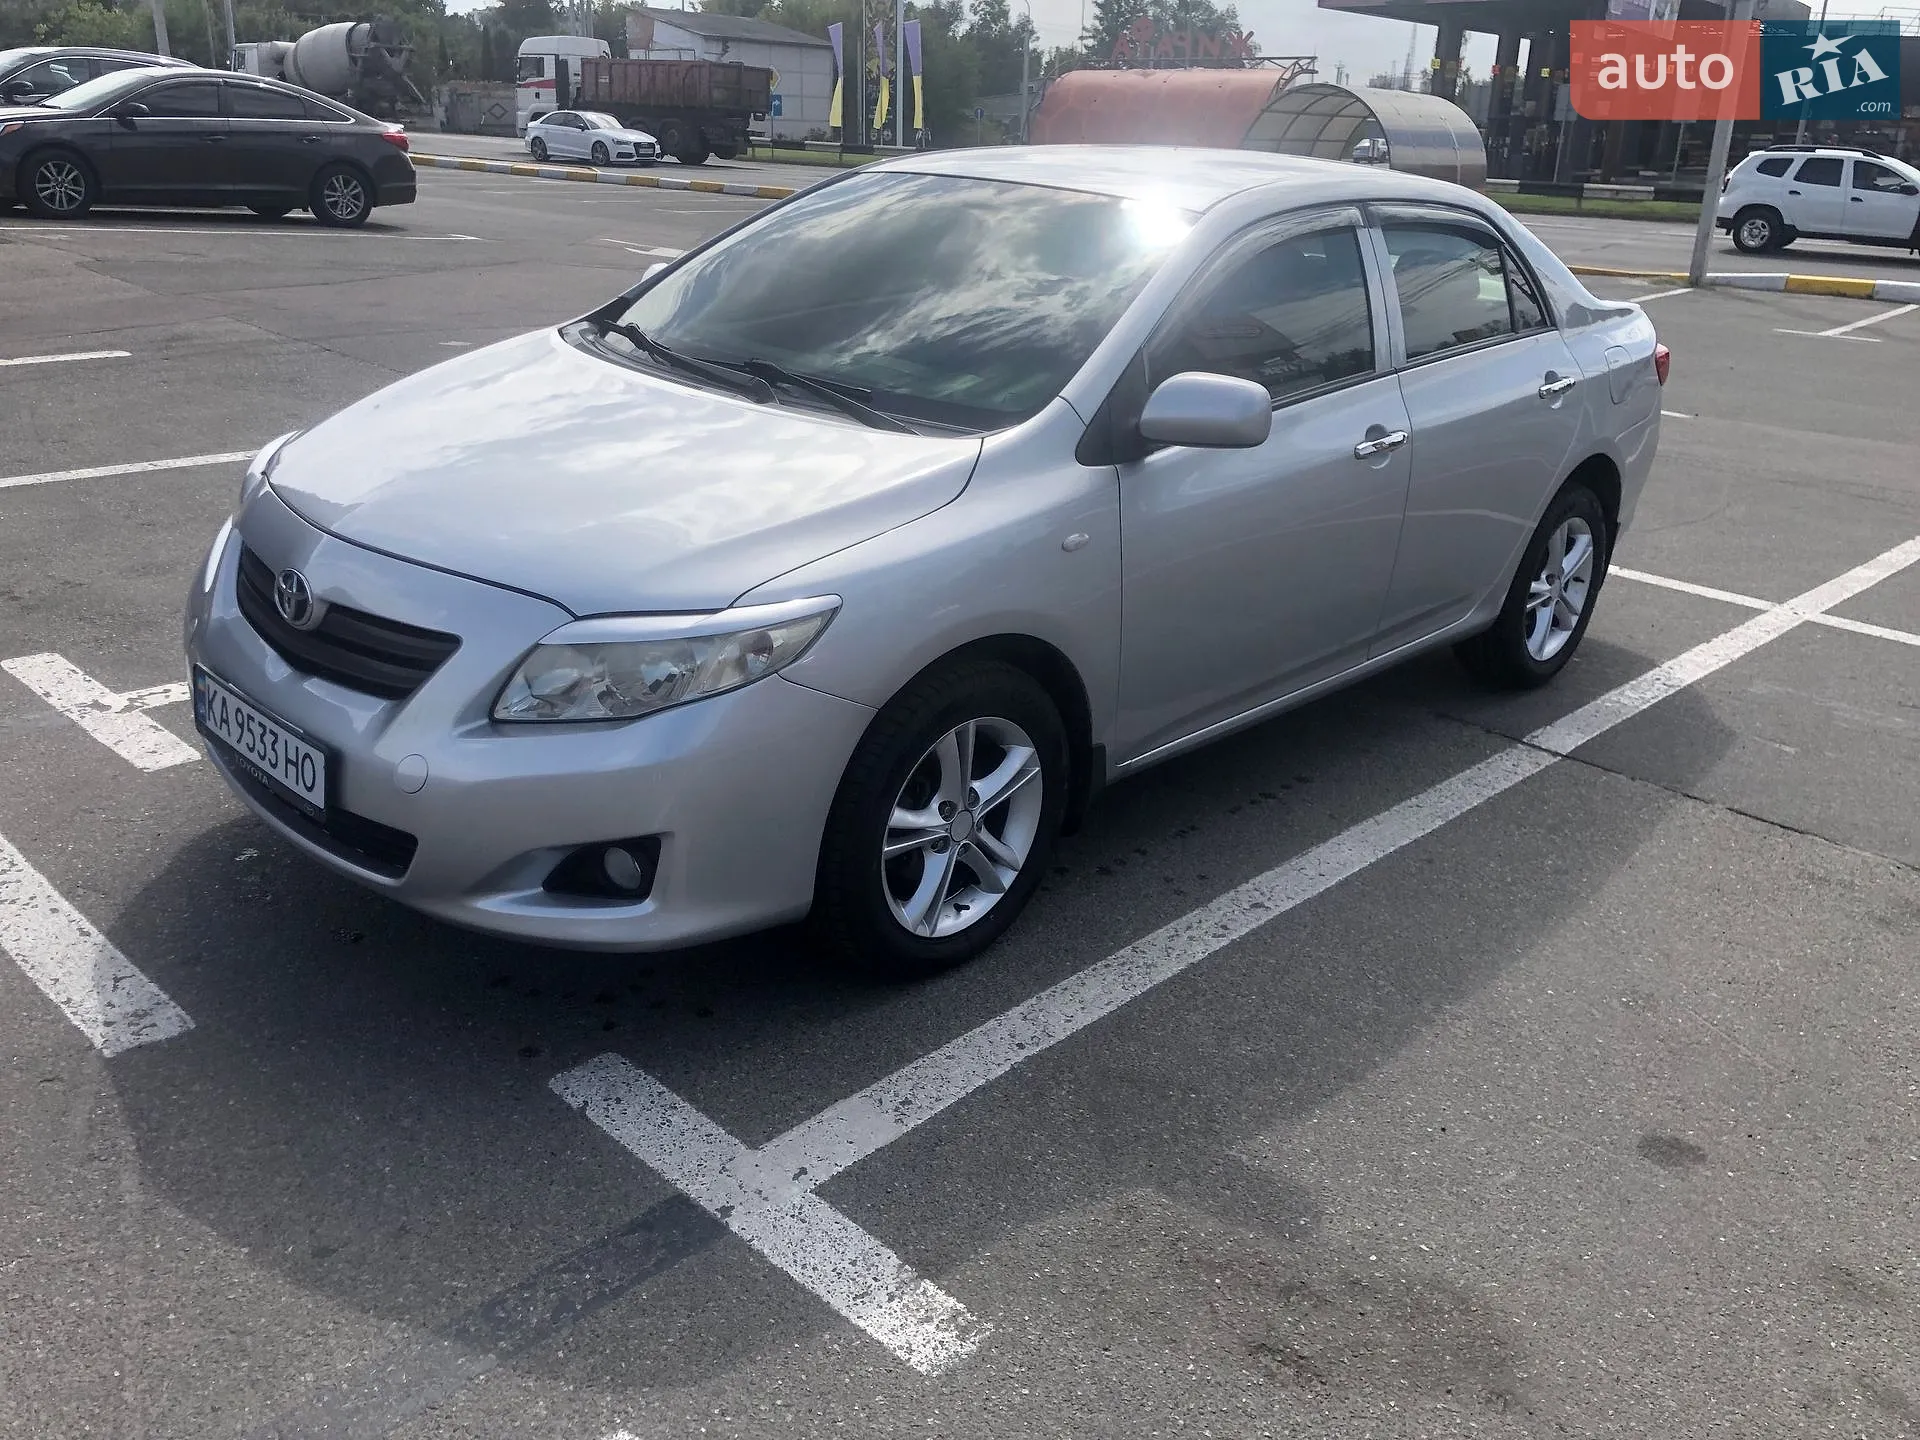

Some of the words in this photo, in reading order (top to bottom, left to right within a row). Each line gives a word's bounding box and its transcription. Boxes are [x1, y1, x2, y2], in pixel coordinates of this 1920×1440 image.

[207, 684, 231, 737] KA
[235, 707, 279, 770] 9533
[284, 738, 316, 793] HO
